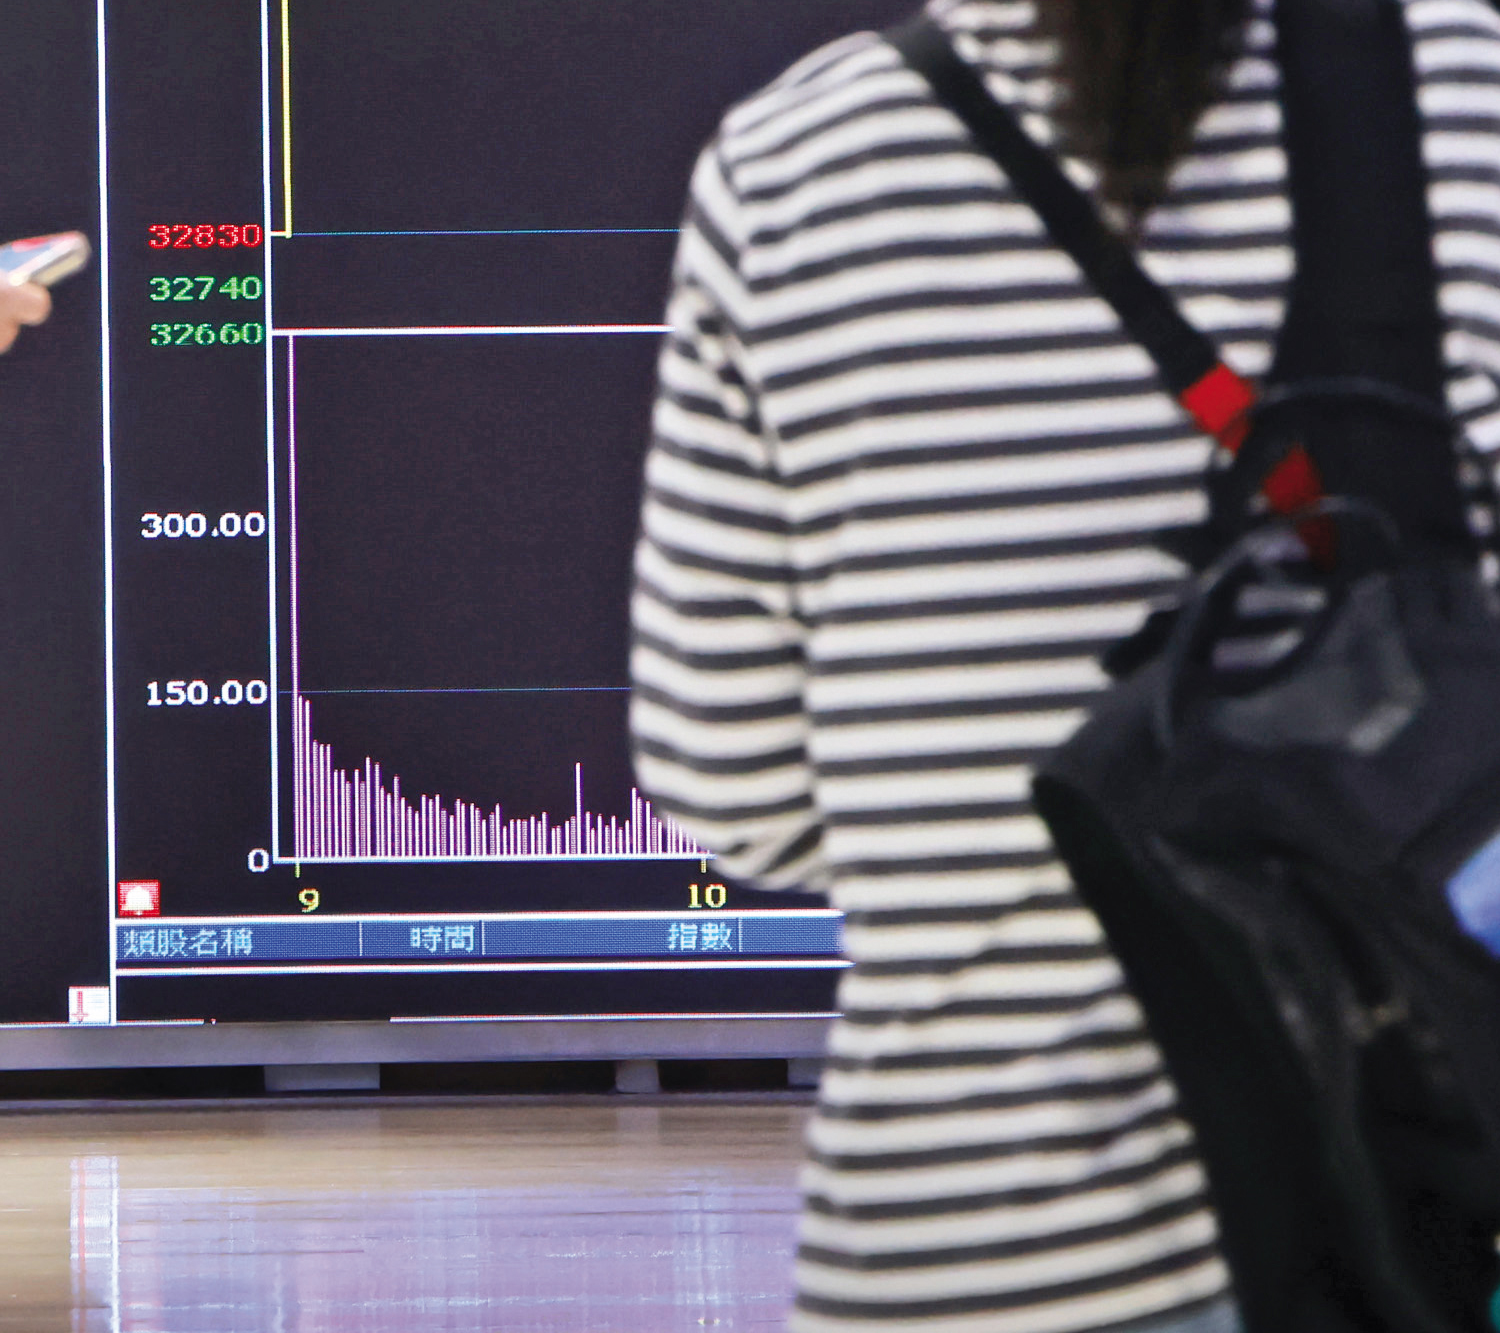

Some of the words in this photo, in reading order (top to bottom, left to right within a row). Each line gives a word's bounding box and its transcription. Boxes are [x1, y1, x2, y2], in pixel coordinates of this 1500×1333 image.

[149, 224, 263, 249] 32830
[150, 276, 262, 301] 32740
[151, 323, 263, 345] 32660
[141, 513, 265, 537] 300.00
[148, 680, 267, 705] 150.00
[299, 889, 319, 910] 9
[689, 885, 726, 906] 10
